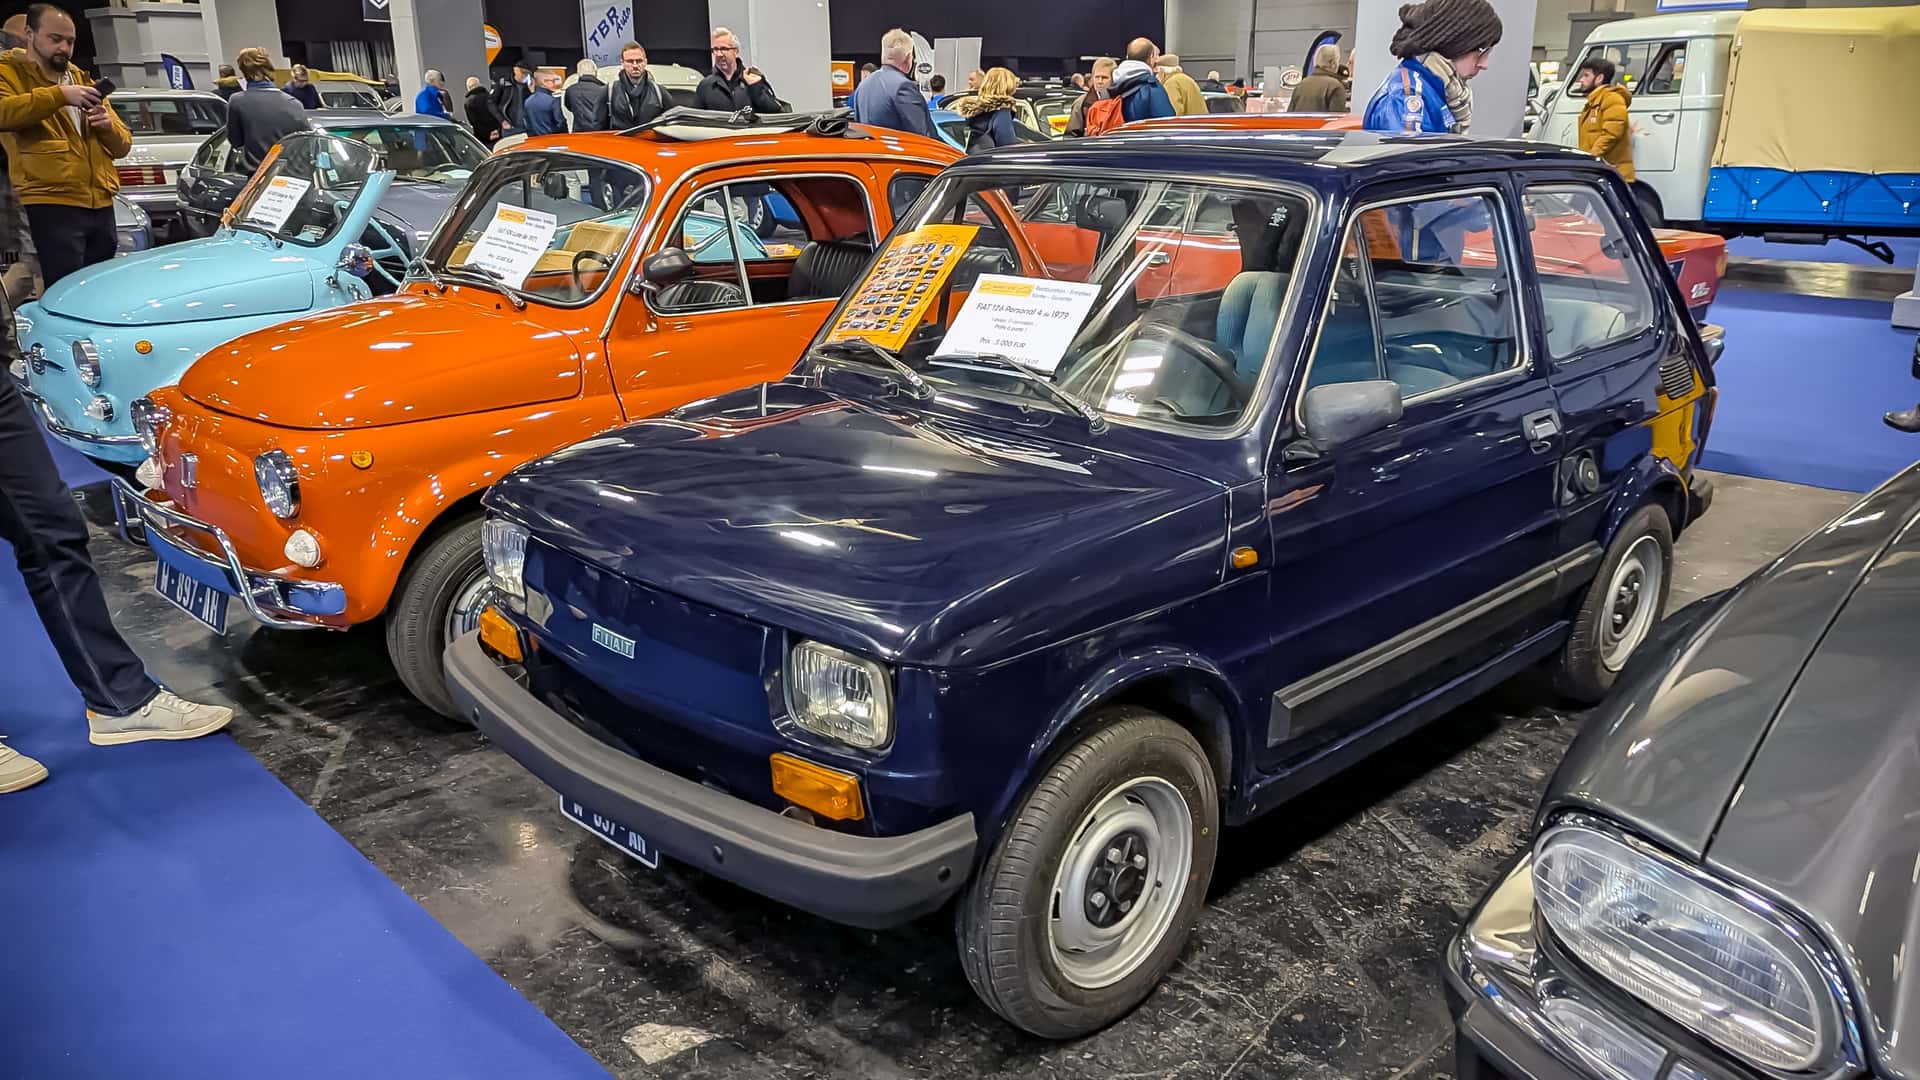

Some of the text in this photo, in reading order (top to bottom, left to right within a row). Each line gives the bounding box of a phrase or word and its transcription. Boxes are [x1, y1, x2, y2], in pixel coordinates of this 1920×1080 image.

[589, 6, 617, 47] TBR
[976, 302, 992, 310] FIAT
[1005, 305, 1037, 315] Personal
[1051, 310, 1070, 320] 1979
[594, 627, 632, 654] FIAT
